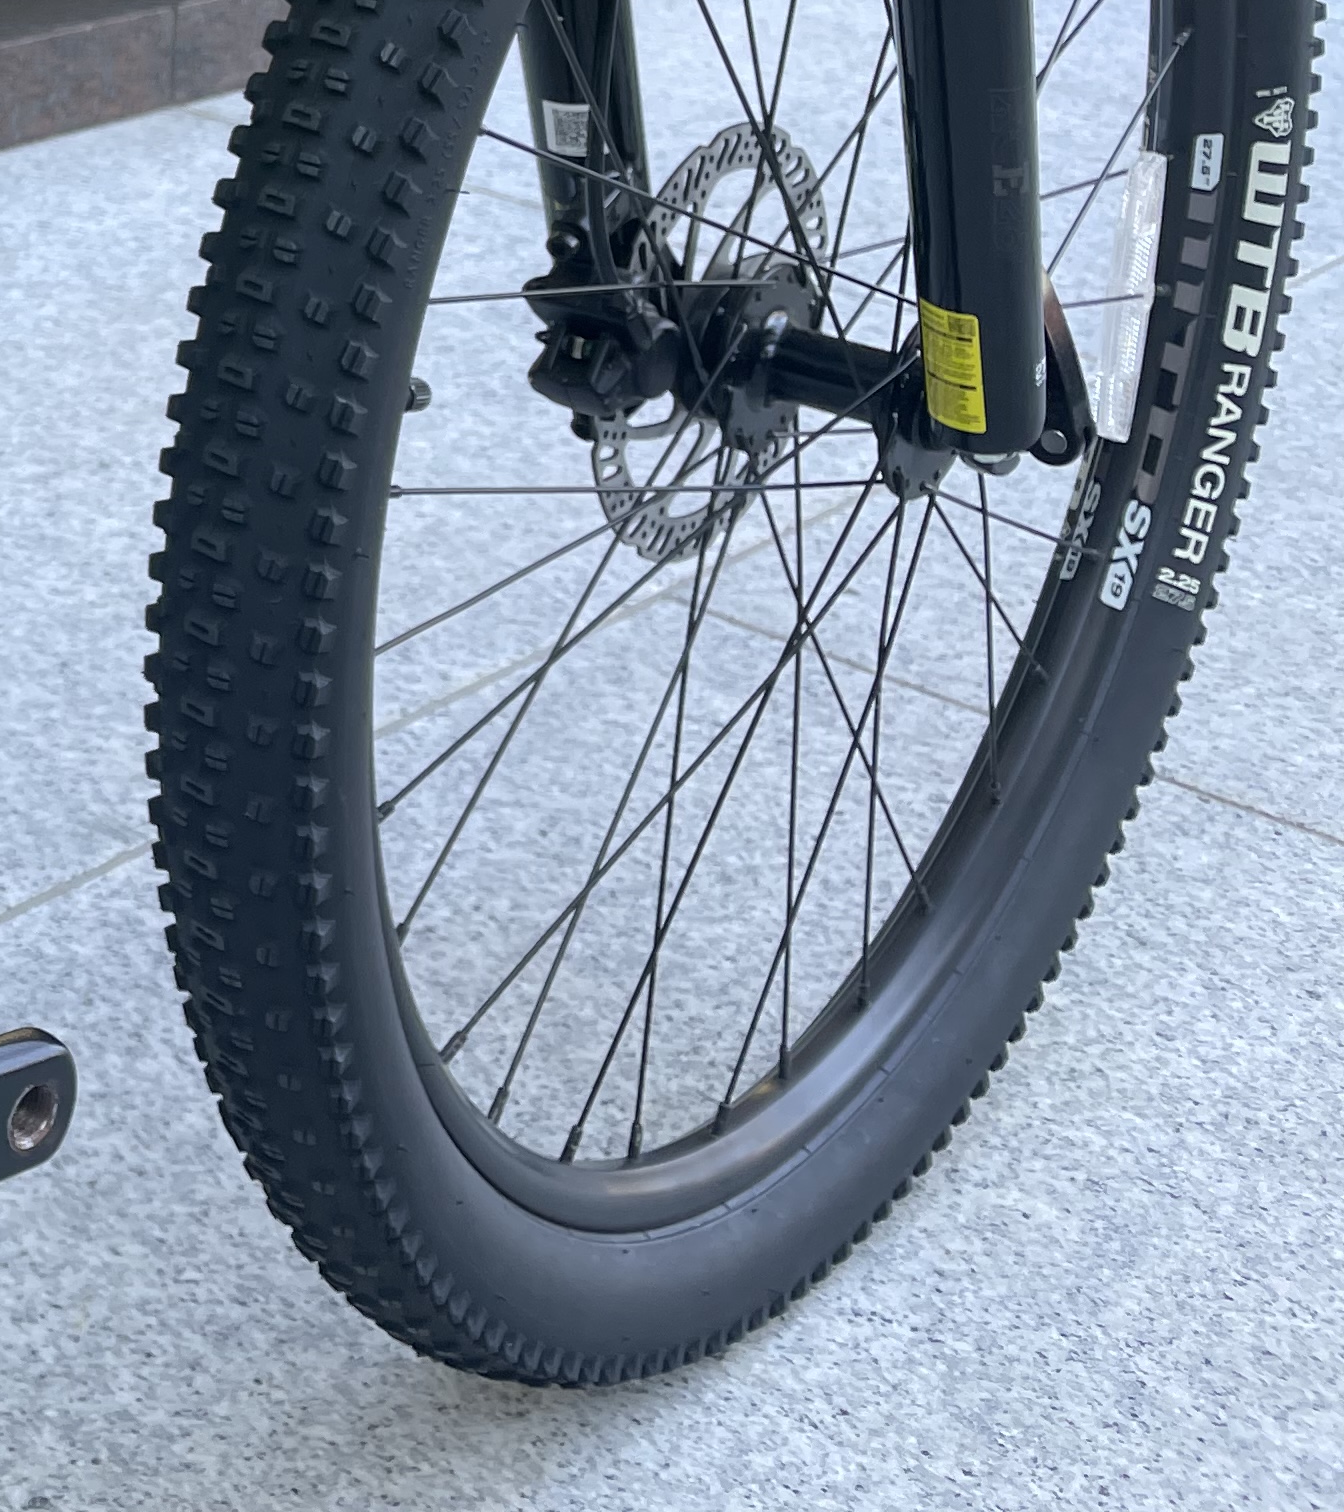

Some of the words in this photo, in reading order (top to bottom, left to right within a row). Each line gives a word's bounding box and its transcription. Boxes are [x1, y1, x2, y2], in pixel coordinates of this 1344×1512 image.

[1222, 140, 1292, 357] WTB
[1173, 363, 1252, 565] RANGER
[1110, 498, 1154, 573] SX
[1107, 571, 1127, 598] 19
[1157, 566, 1201, 594] 2.25
